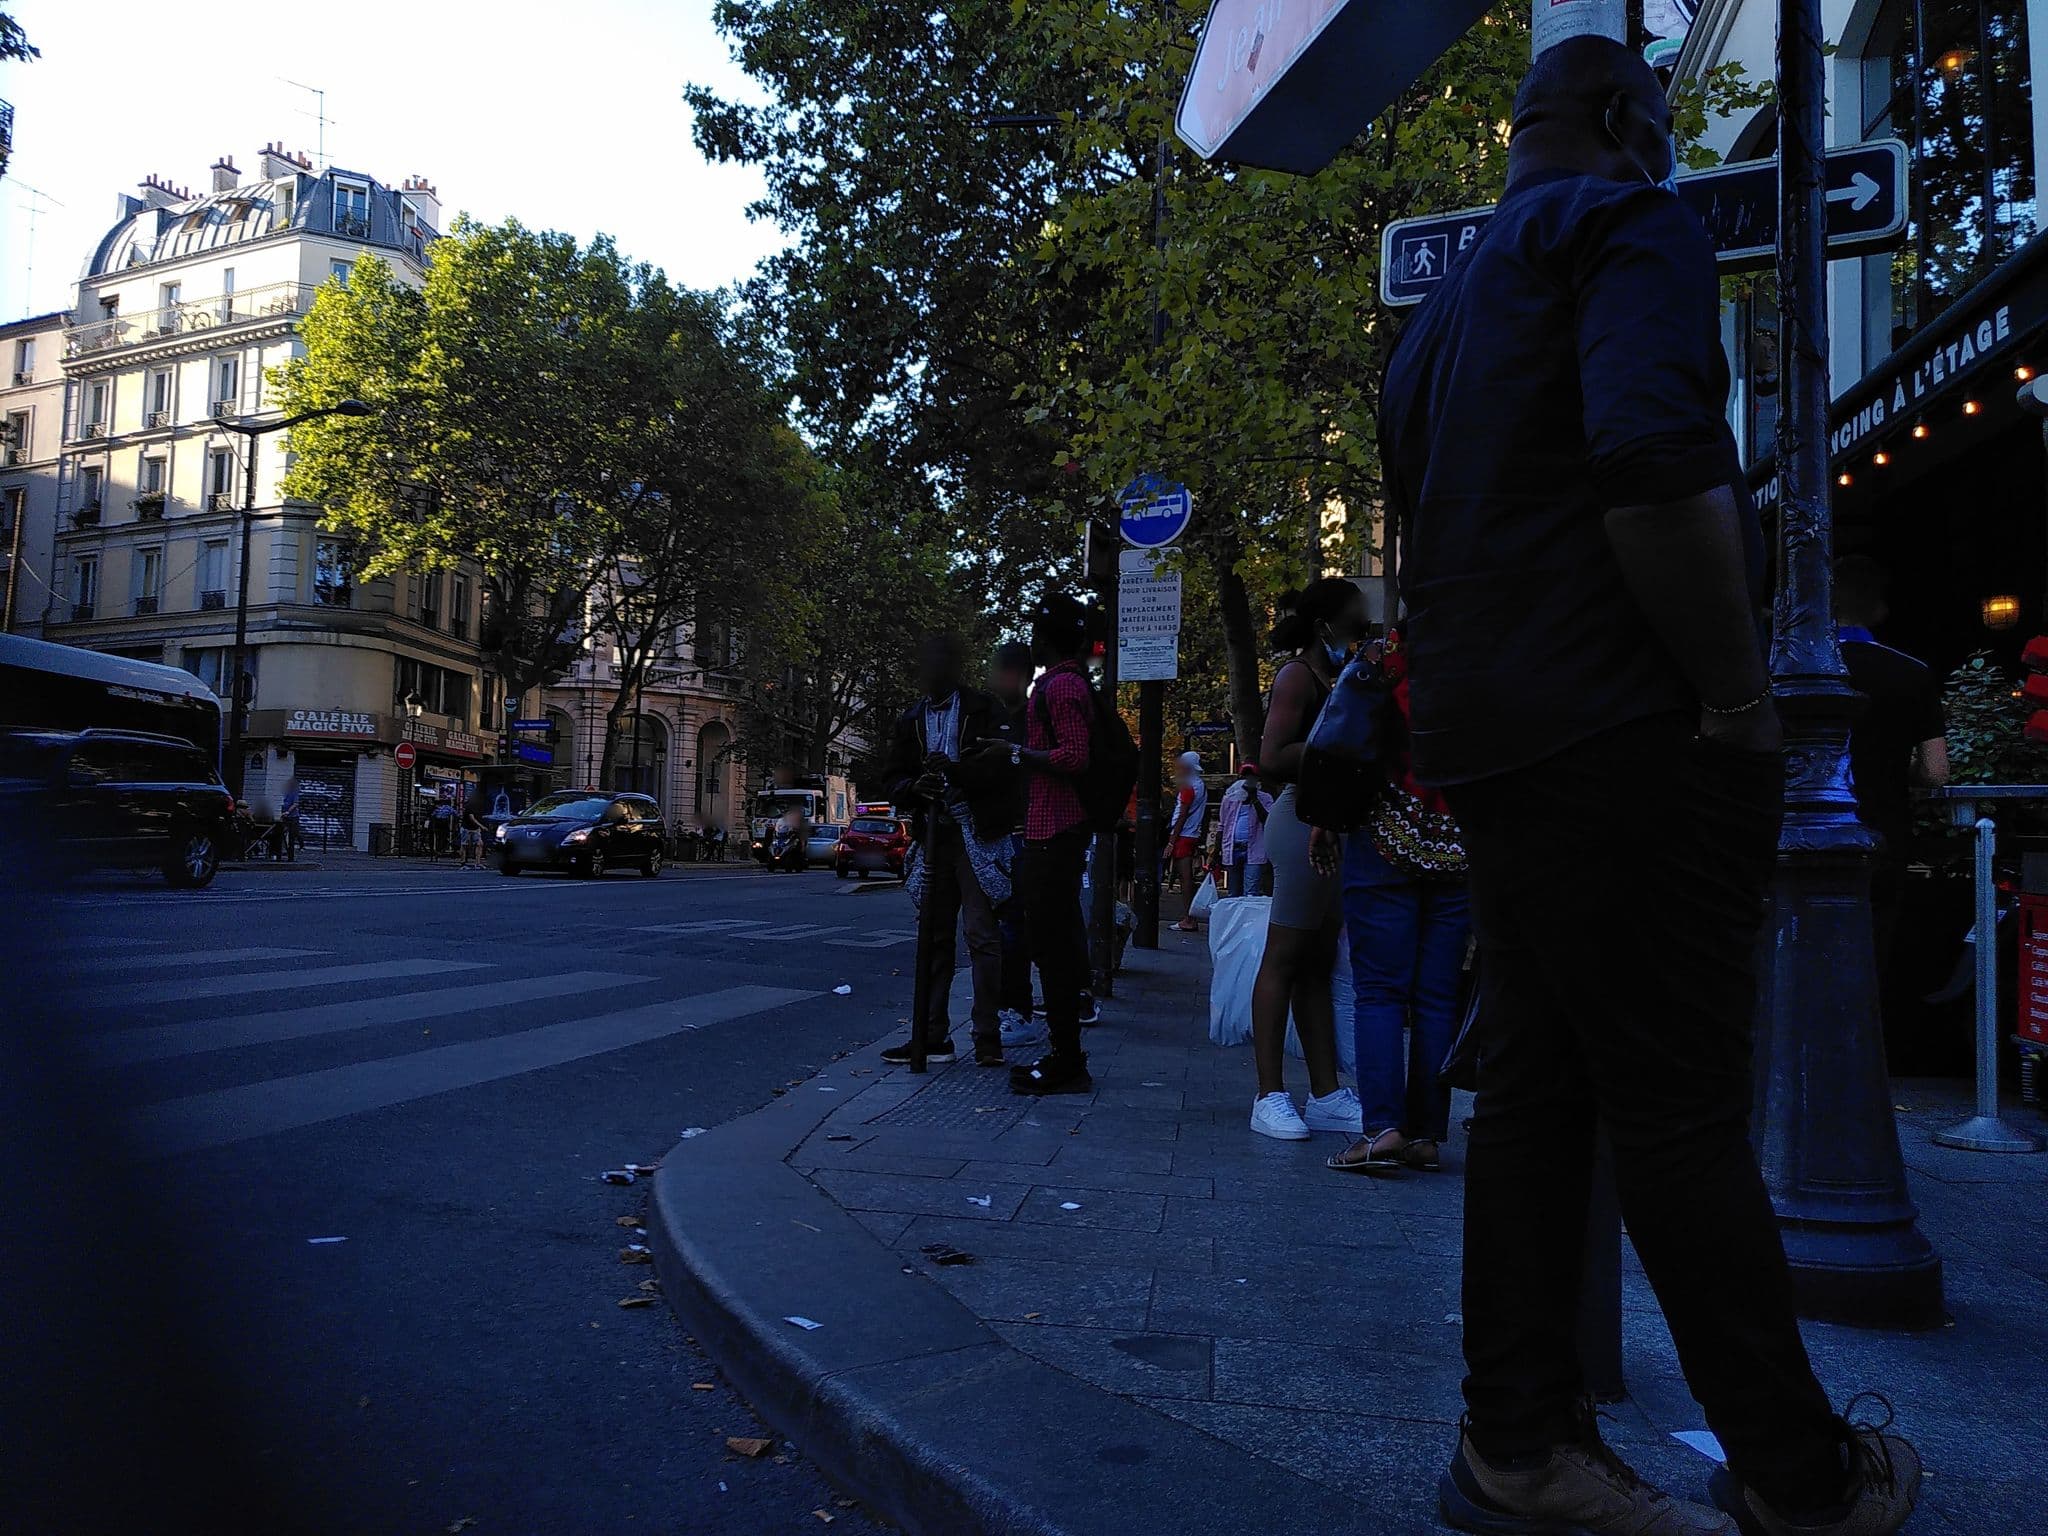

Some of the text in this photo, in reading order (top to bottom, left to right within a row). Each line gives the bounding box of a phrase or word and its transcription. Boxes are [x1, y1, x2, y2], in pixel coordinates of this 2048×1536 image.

[1831, 305, 2011, 457] NCING À L'ÉTAGE
[1121, 585, 1177, 595] POUR LIVRAISON
[1121, 605, 1176, 614] EMPLACEMENT
[293, 710, 369, 724] GALERIE
[286, 720, 376, 734] MAGIC FIVE
[446, 738, 465, 751] MAGIC
[448, 730, 477, 745] GALERIE
